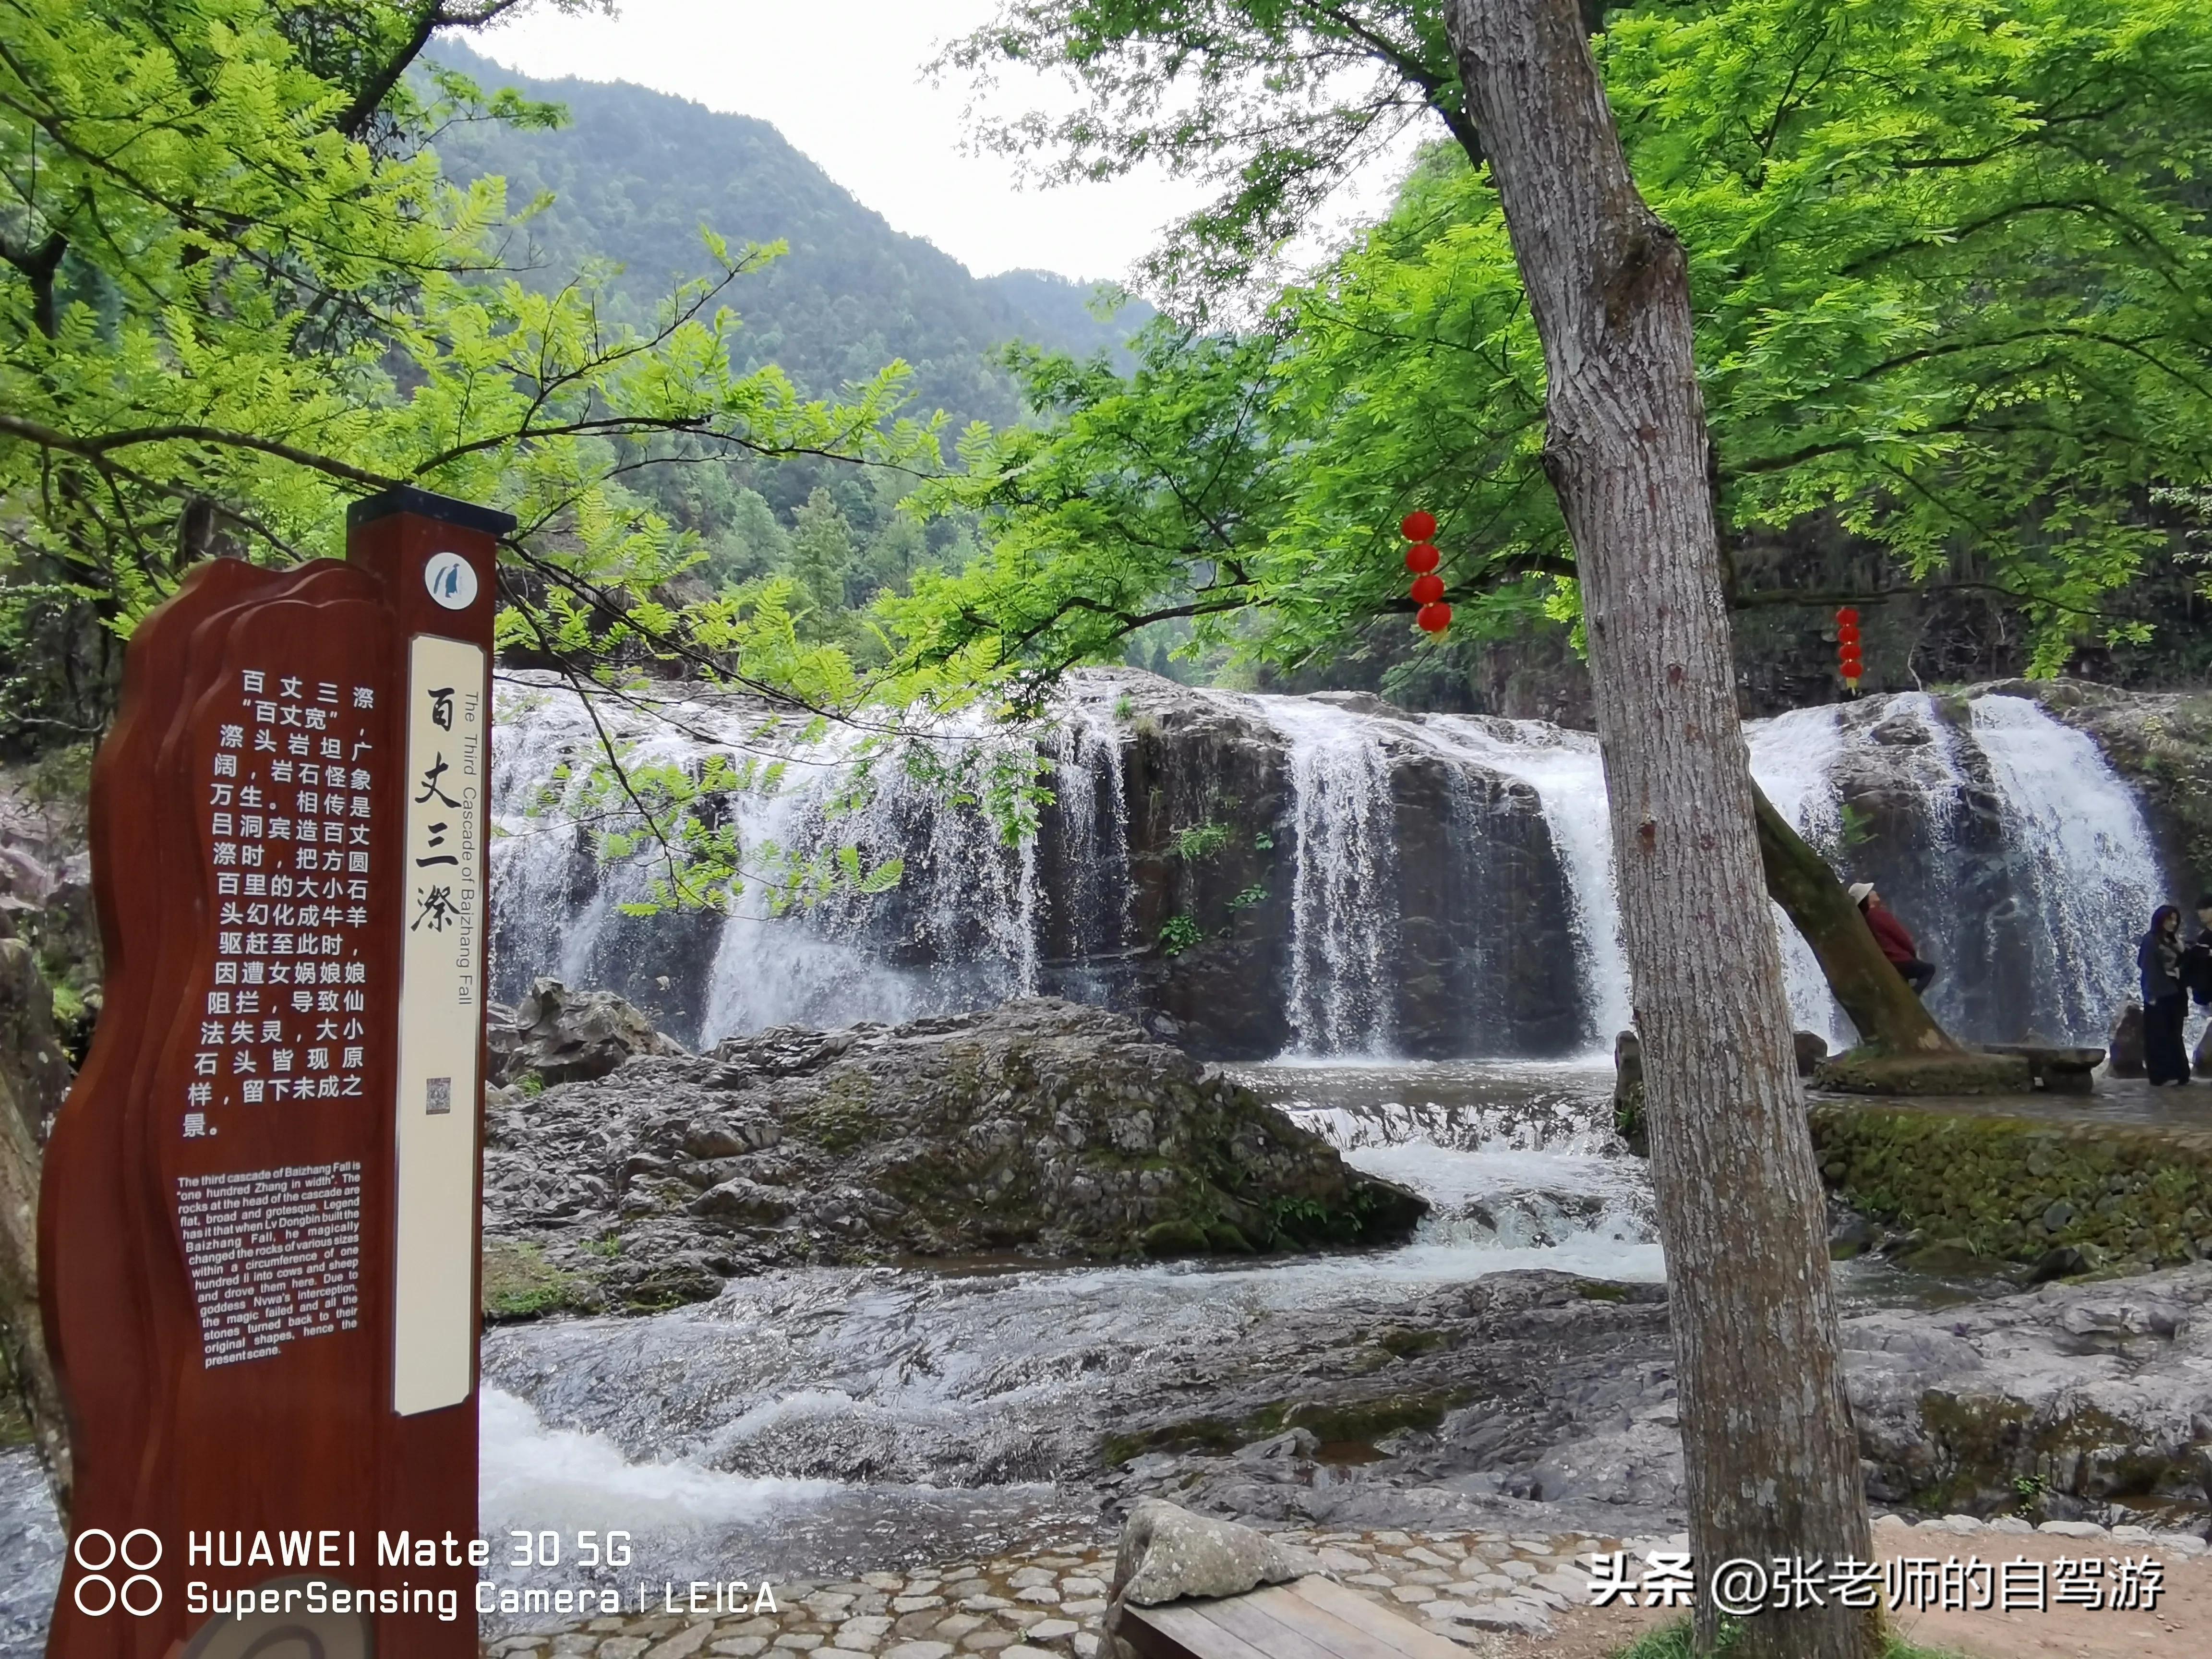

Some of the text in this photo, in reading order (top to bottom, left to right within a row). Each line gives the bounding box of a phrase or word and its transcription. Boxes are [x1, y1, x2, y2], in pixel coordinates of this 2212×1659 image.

[242, 670, 373, 708] 百丈三漈
[220, 724, 372, 761] 漈头岩坦广
[210, 783, 371, 817] 万生。相传是
[411, 687, 462, 933] 百丈三漈
[212, 813, 370, 845] 吕洞宾造百丈
[455, 691, 479, 1005] The Third Cascade of Baizhang Fall
[217, 872, 368, 900] 百里的大小石
[220, 902, 367, 927] 头幻化成牛羊
[216, 962, 365, 984] 因遭女娲娘娘
[194, 1046, 363, 1076] 石头皆现原
[183, 1113, 217, 1137] 景。
[178, 1161, 361, 1188] The third cascade of Baizhang Fall is
[206, 1184, 250, 1198] hundred
[254, 1181, 287, 1193] Zhang
[292, 1179, 301, 1188] in
[342, 1173, 360, 1183] The
[178, 1203, 207, 1214] rocks
[211, 1200, 221, 1210] at
[224, 1199, 240, 1208] the
[243, 1195, 268, 1206] head
[271, 1194, 281, 1204] of
[283, 1192, 299, 1202] the
[301, 1188, 342, 1200] cascade
[206, 1213, 237, 1223] broad
[242, 1209, 261, 1219] and
[324, 1197, 360, 1211] Legend
[183, 1210, 359, 1239] has it that when Lv Dongbin built the
[186, 1237, 241, 1252] Baizhang
[286, 1230, 299, 1239] he
[308, 1222, 359, 1237] magically
[189, 1235, 359, 1265] changed the rocks of various sizes
[192, 1265, 223, 1277] within
[246, 1251, 317, 1270] circumference
[325, 1249, 334, 1258] of
[341, 1246, 359, 1256] one
[195, 1259, 358, 1290] hundred li into cows and sheep
[198, 1271, 358, 1302] and drove them here. Due to
[200, 1301, 246, 1318] goddess
[203, 1295, 357, 1327] the magic failed and all the
[204, 1307, 358, 1340] stones turned back to their
[204, 1338, 245, 1354] original
[303, 1324, 334, 1336] hence
[342, 1320, 357, 1329] the
[205, 1351, 246, 1369] present
